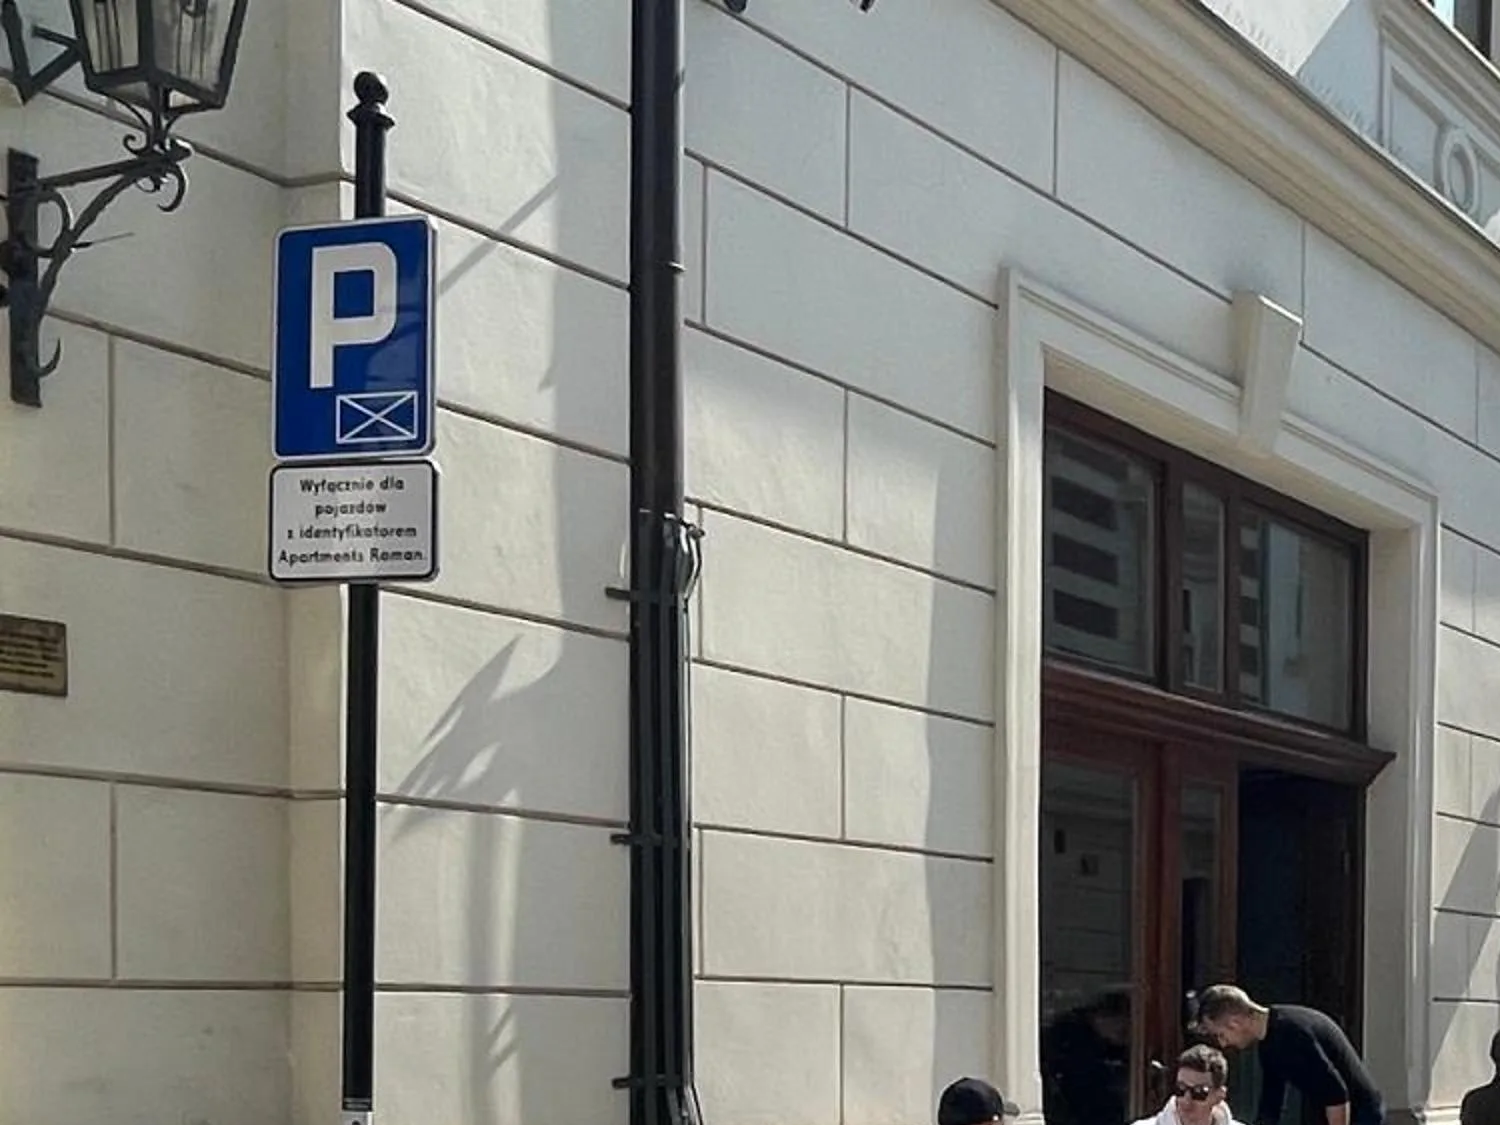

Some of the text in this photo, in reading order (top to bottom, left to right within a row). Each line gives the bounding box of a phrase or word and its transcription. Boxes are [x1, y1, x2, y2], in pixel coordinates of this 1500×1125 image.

[310, 241, 398, 390] P
[379, 475, 405, 491] dla
[287, 523, 417, 541] z identyfikatorem
[278, 549, 364, 568] Apartments
